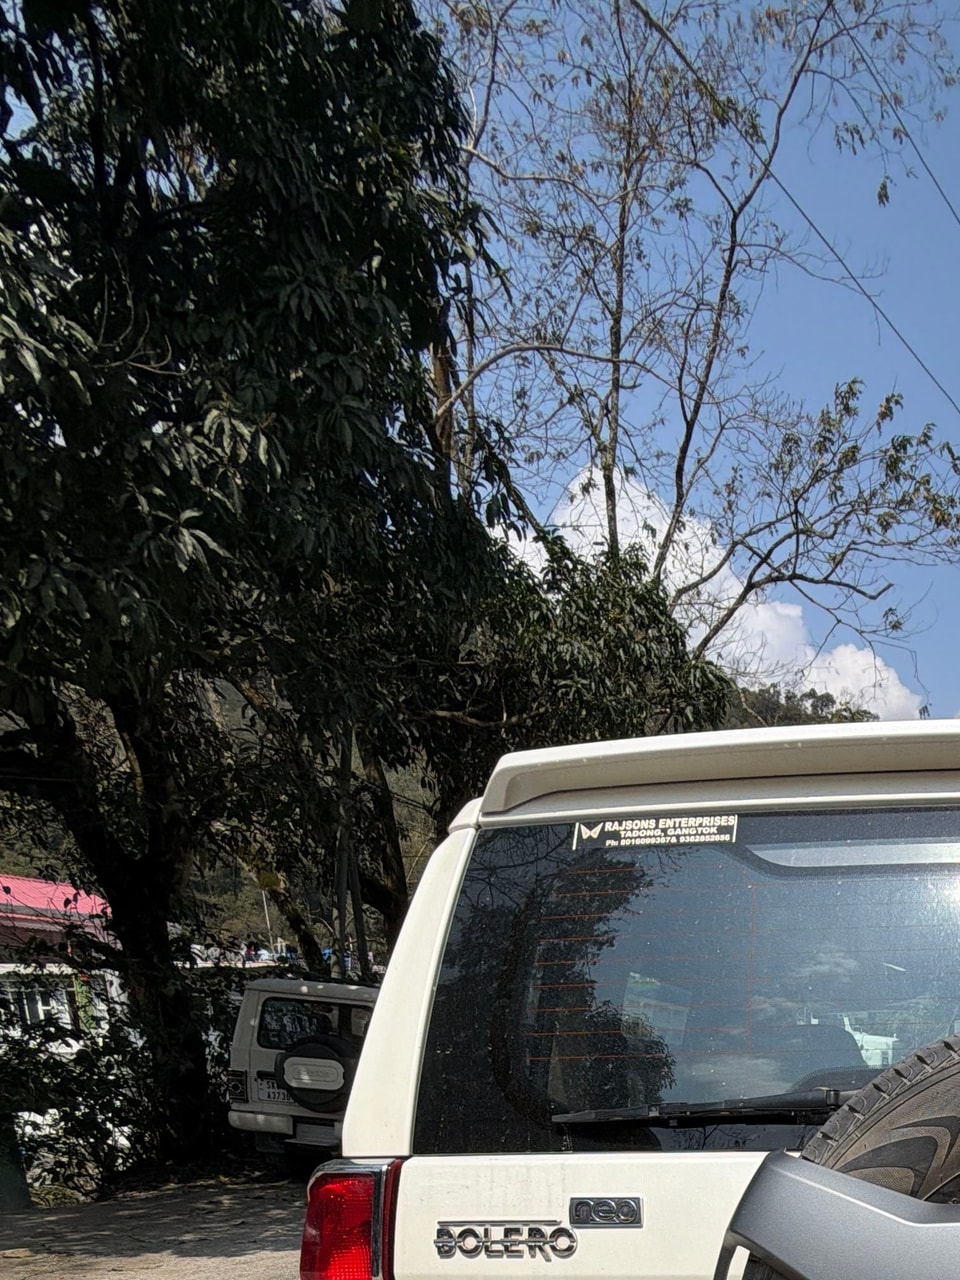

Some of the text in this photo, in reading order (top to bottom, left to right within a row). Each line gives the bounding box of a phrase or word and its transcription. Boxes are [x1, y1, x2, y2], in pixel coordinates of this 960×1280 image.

[604, 815, 736, 832] RAJSONS ENTERPRISES
[619, 826, 718, 838] TADONG, GANGTOK
[574, 1199, 640, 1224] neo
[434, 1226, 579, 1262] BOLERO
